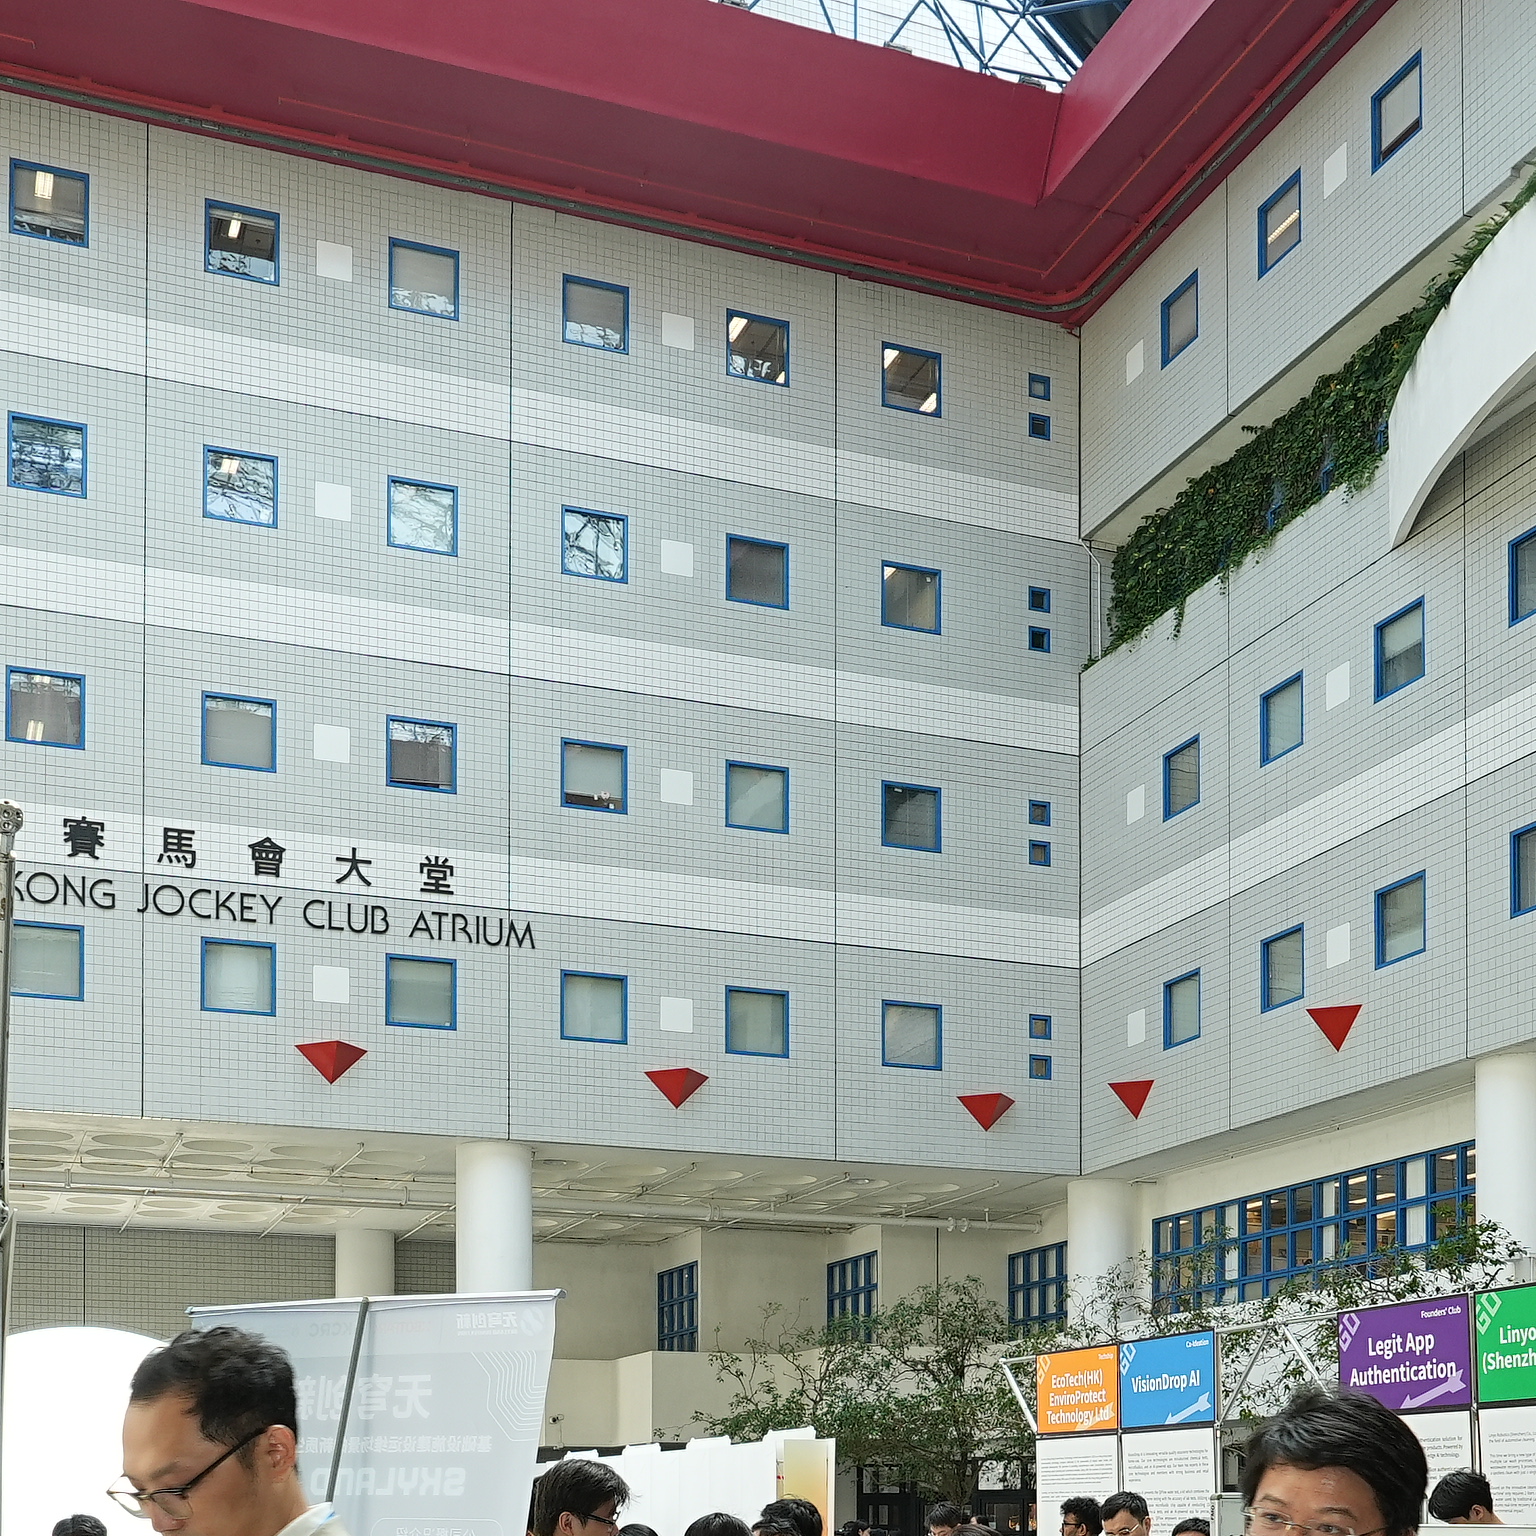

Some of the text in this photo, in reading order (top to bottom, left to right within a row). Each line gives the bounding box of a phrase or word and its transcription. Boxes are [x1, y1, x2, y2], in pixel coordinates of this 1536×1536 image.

[14, 870, 116, 911] KONG
[136, 883, 282, 925] JOCKEY
[303, 899, 390, 934] CLUB
[409, 911, 536, 950] ATRIUM
[1368, 1332, 1435, 1359] Legit App
[1499, 1323, 1536, 1347] Linyo
[1051, 1368, 1104, 1389] EcoTech(HK)
[1131, 1370, 1201, 1393] VisionDrop AI
[1350, 1360, 1457, 1387] Authentication
[1049, 1388, 1106, 1407] EnviroProtect
[1046, 1406, 1110, 1426] Technology Ltd
